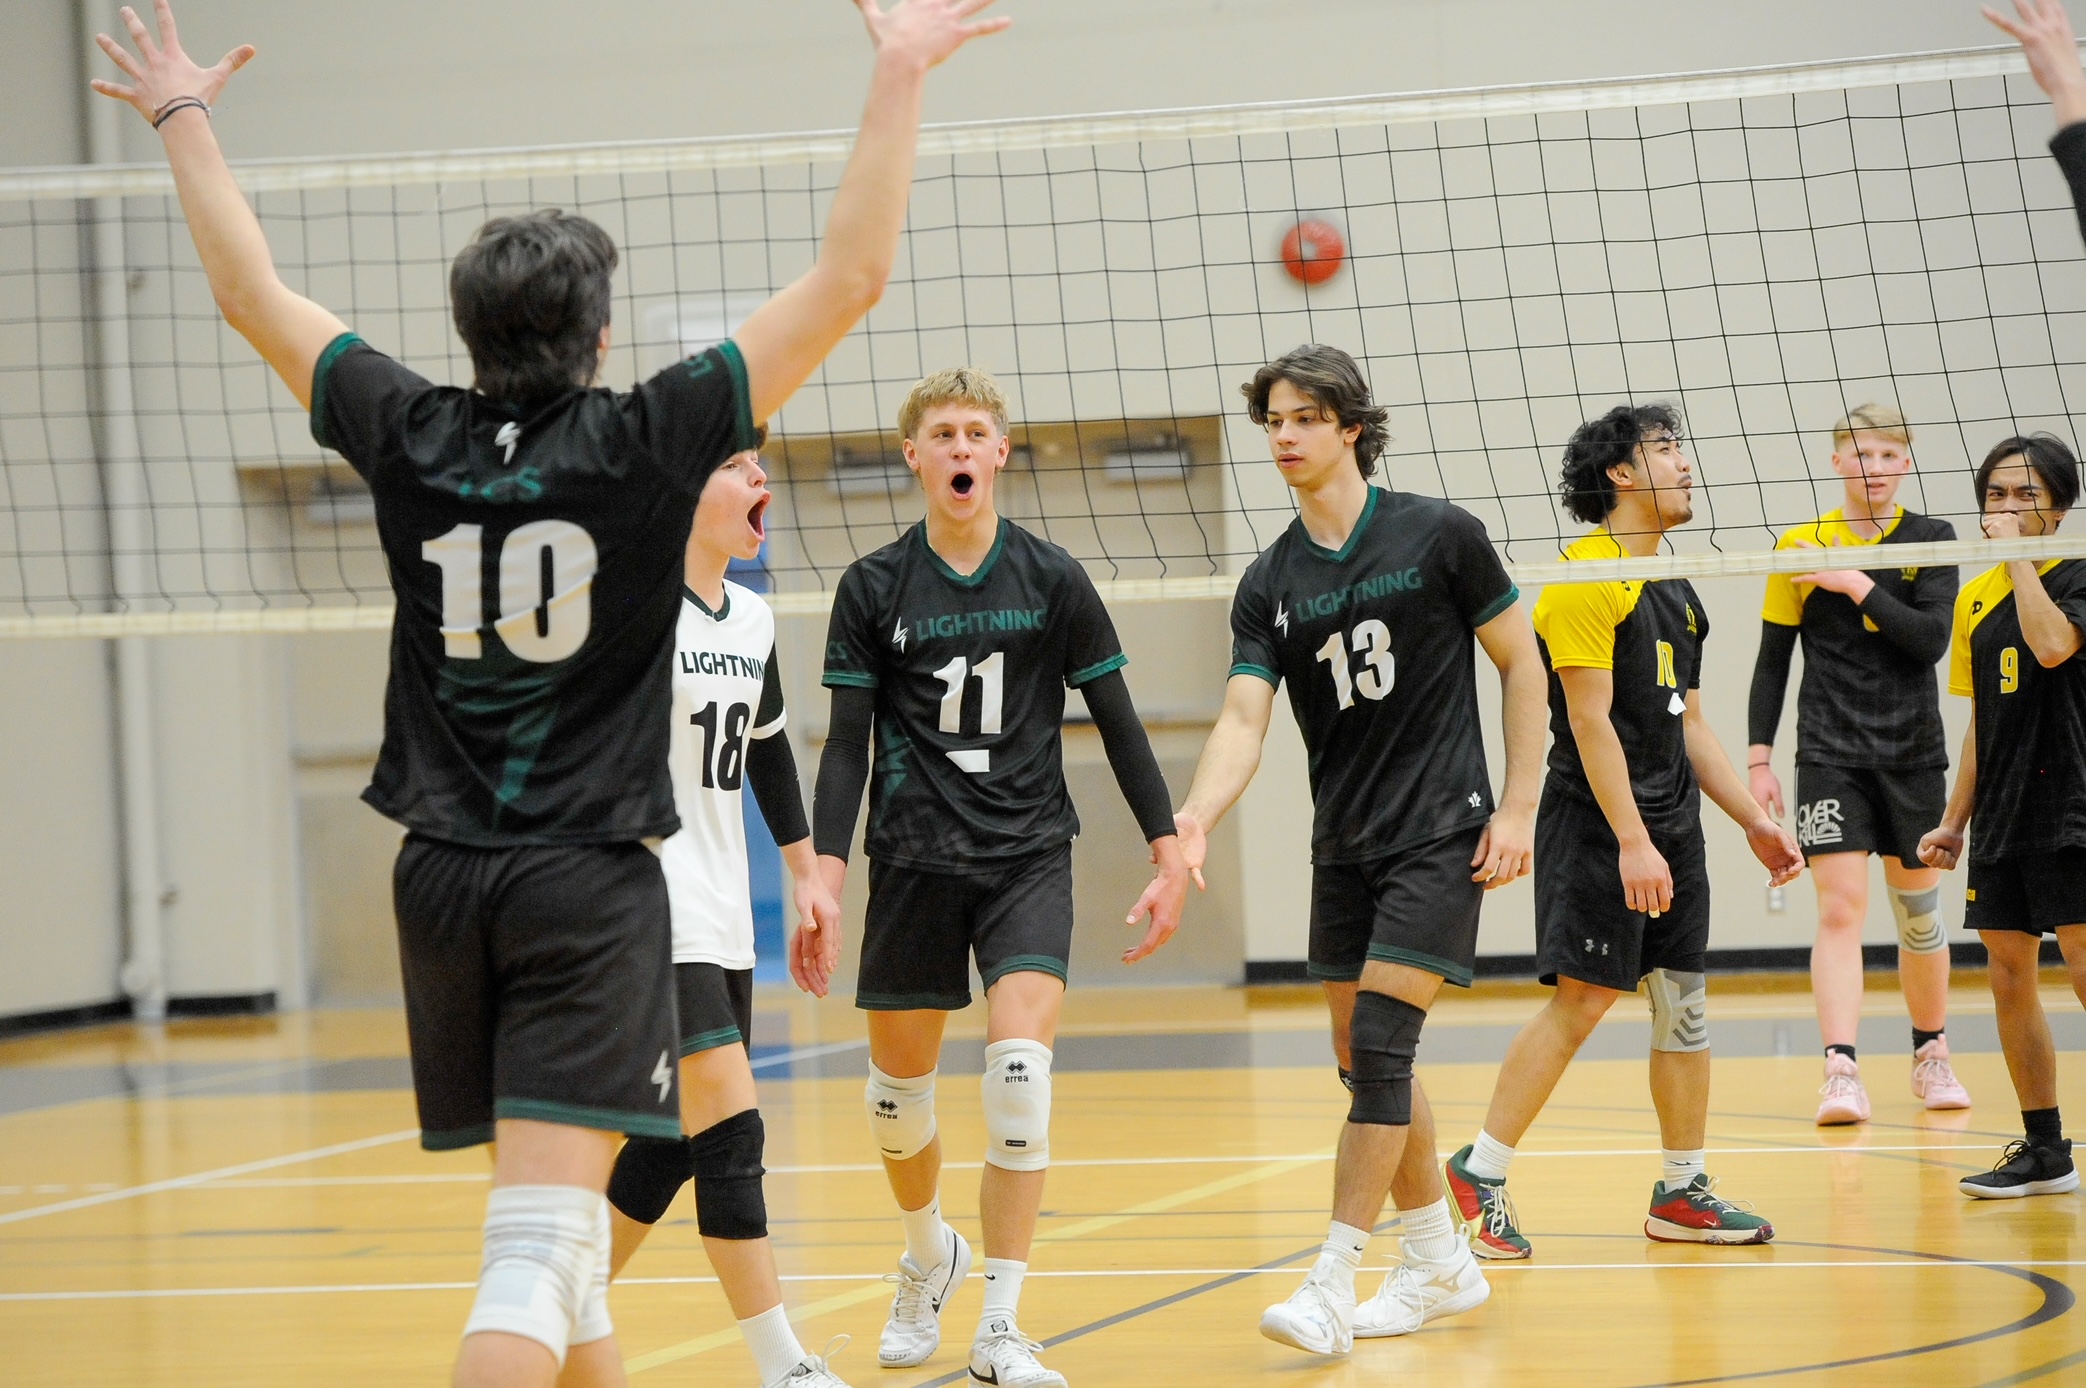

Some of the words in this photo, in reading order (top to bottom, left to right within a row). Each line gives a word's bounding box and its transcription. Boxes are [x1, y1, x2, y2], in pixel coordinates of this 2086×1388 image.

[422, 519, 598, 663] 10
[1294, 567, 1423, 623] LIGHTNING
[914, 608, 1048, 642] LIGHTNING
[679, 651, 764, 681] LIGHTNIN
[1315, 619, 1395, 711] 13
[1656, 638, 1677, 689] 10
[2000, 646, 2019, 694] 9
[932, 652, 1004, 734] 11
[689, 701, 750, 791] 18
[1798, 798, 1845, 828] OVER
